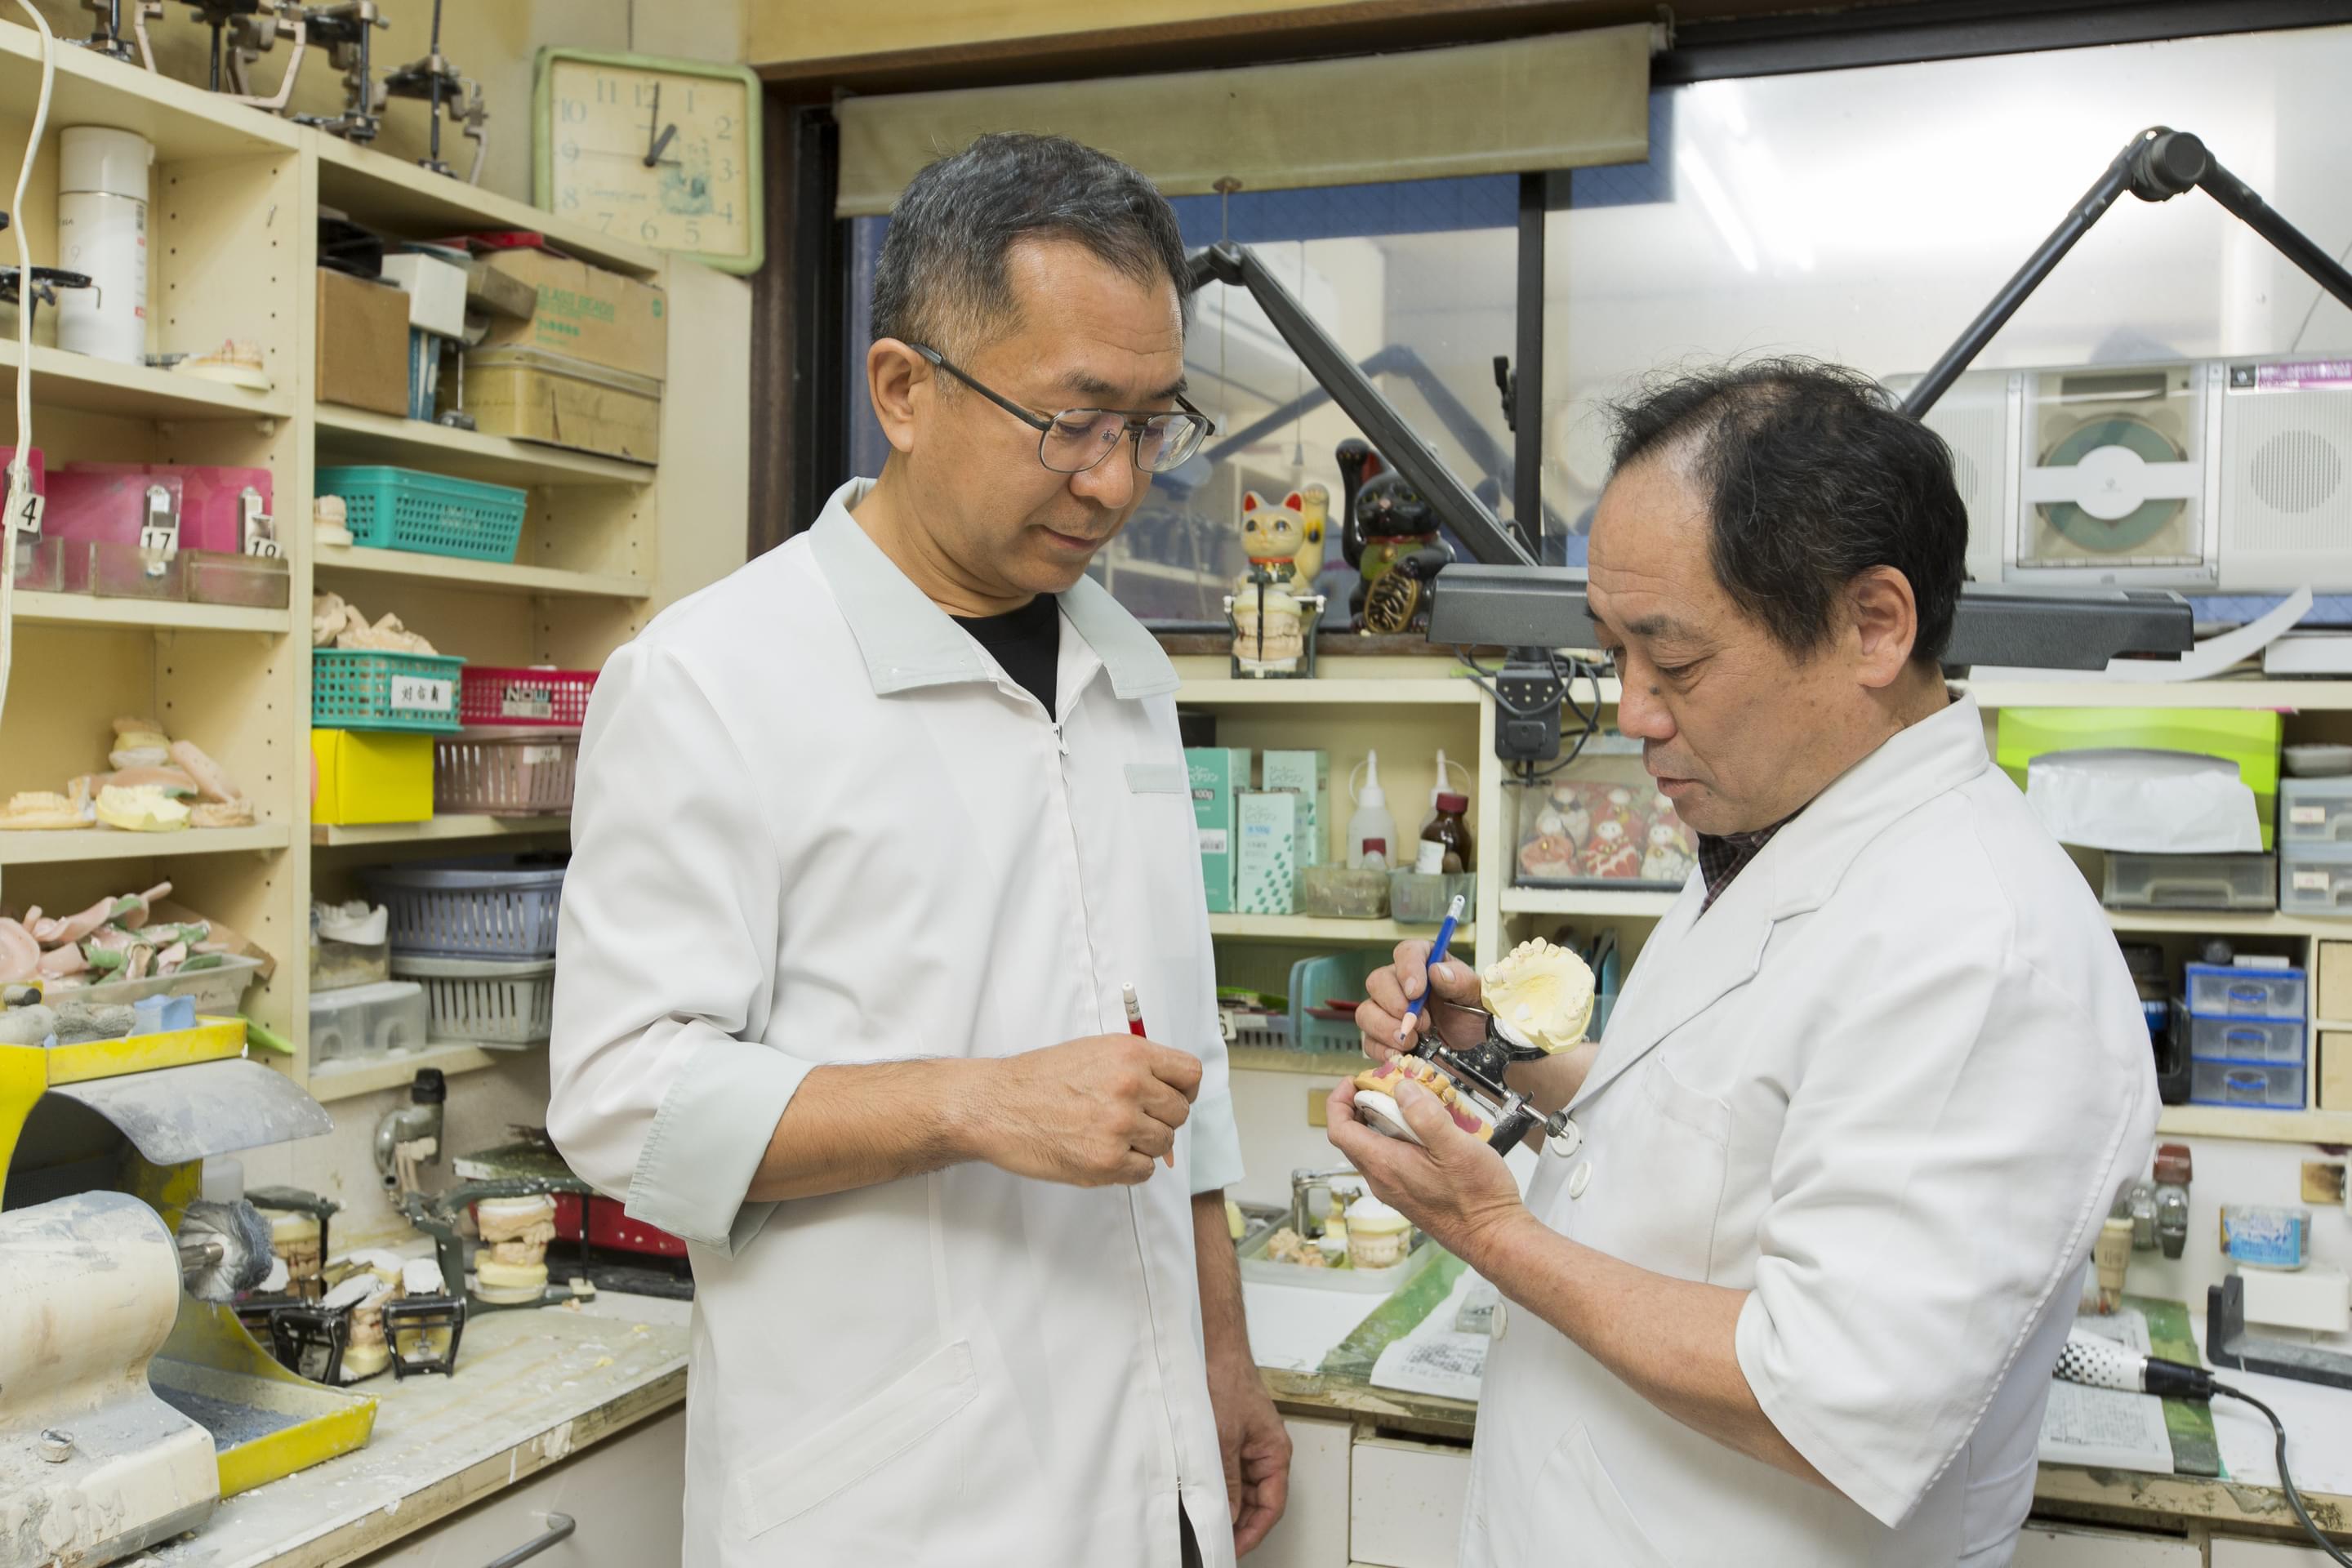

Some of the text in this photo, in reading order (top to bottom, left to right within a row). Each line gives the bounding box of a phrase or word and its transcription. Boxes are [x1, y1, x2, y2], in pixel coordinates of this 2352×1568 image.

[596, 78, 617, 105] 11
[687, 90, 693, 114] 1
[561, 98, 587, 122] 10
[715, 116, 733, 140] 2
[561, 140, 581, 161] 9
[718, 159, 733, 183] 3
[561, 187, 580, 210] 8
[597, 212, 614, 234] 7
[716, 202, 733, 225] 4
[640, 218, 659, 242] 6
[684, 220, 701, 244] 5
[20, 497, 38, 527] 4
[145, 532, 172, 550] 17
